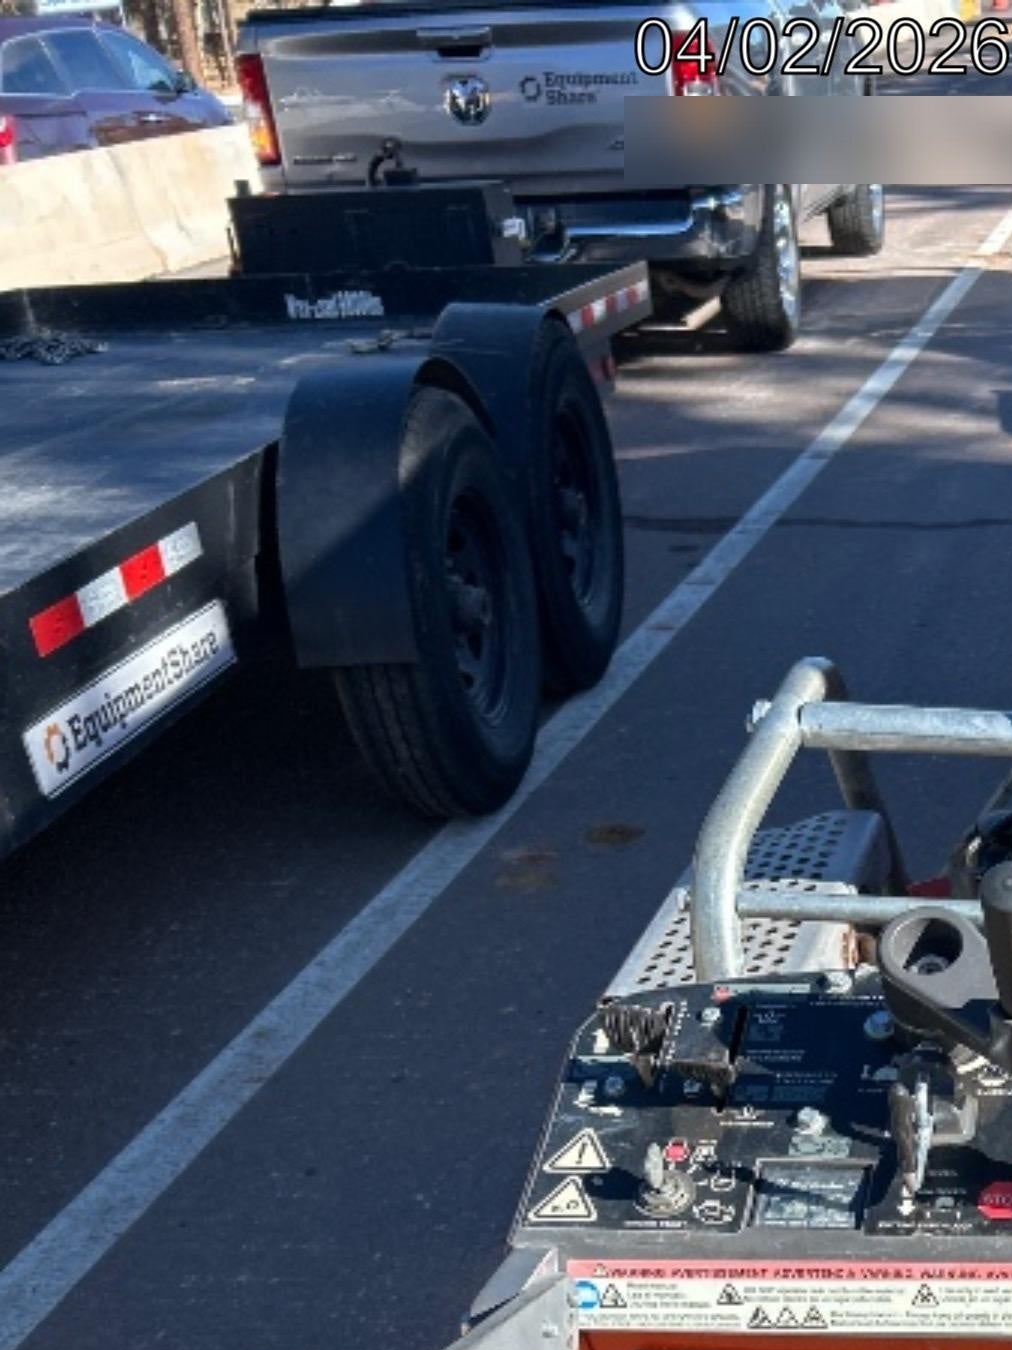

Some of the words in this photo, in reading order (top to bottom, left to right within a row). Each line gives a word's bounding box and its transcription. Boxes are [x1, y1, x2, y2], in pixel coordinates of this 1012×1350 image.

[543, 72, 638, 88] Equipment
[545, 90, 595, 105] Share
[67, 631, 219, 752] EquipmentShare
